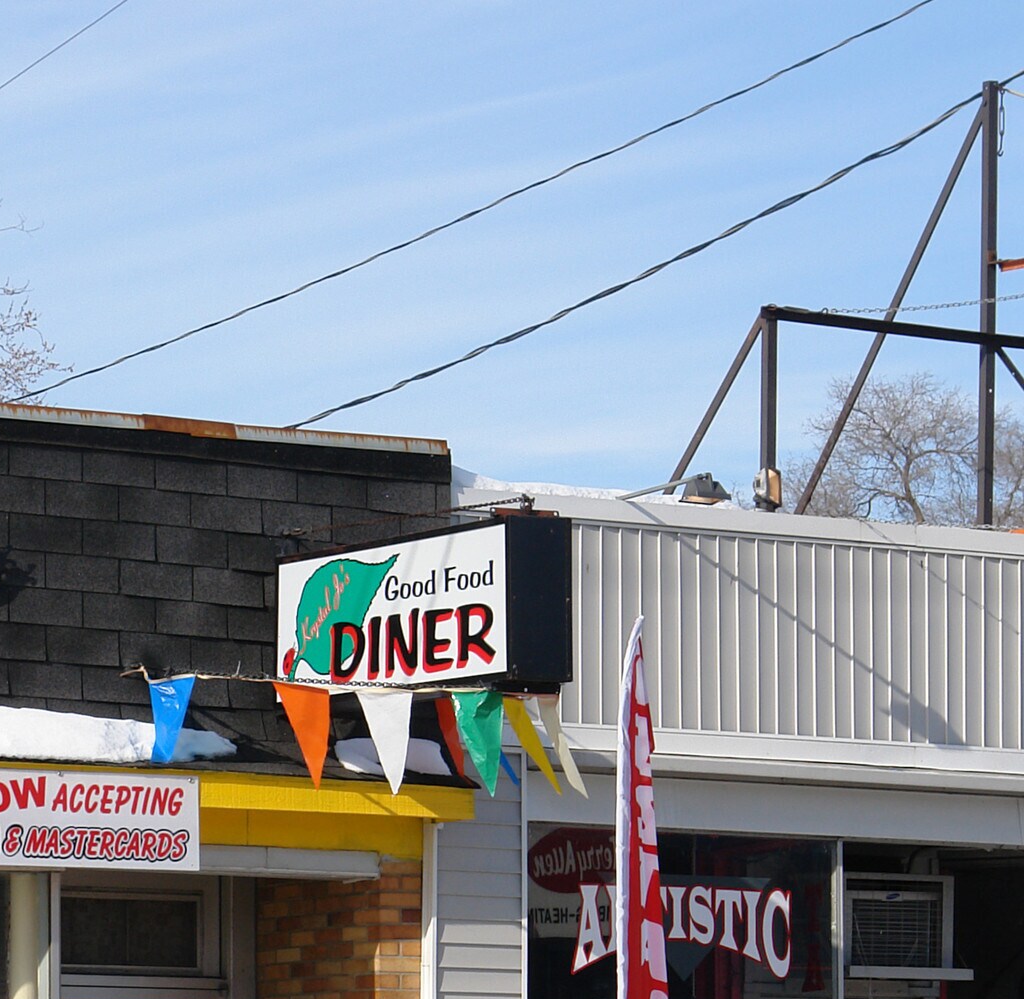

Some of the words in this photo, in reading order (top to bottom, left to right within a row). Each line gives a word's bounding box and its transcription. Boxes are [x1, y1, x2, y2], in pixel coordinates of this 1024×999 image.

[384, 570, 436, 601] Good
[444, 560, 494, 592] Food
[330, 603, 496, 683] DINER
[51, 783, 184, 816] ACCEPTING
[2, 824, 23, 857] &
[25, 826, 190, 862] MASTERCARDS
[570, 882, 792, 980] AISTIC
